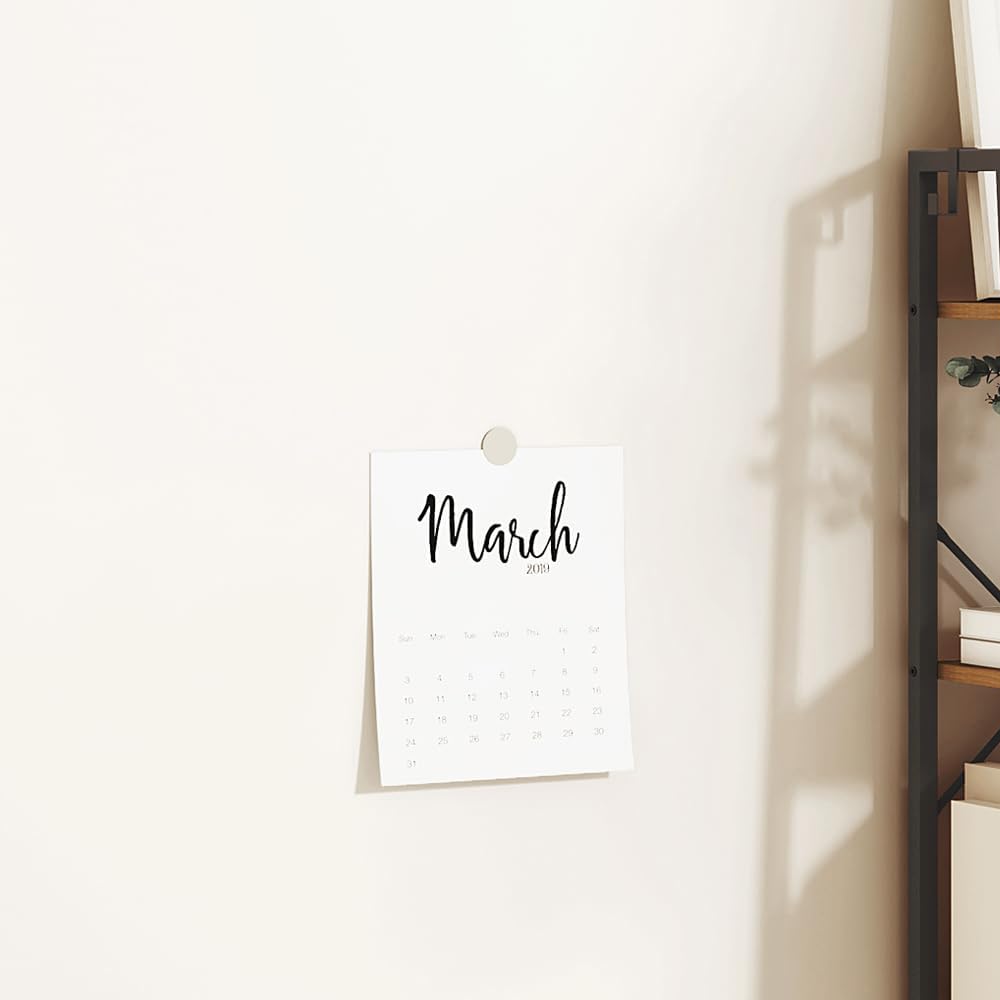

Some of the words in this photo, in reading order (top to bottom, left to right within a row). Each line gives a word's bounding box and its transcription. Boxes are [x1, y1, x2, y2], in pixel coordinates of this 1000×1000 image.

[417, 480, 580, 563] March
[526, 563, 550, 575] 2019
[403, 696, 415, 705] 10
[436, 695, 446, 703] 11
[467, 693, 478, 702] 12
[499, 692, 510, 701] 13
[530, 689, 541, 697] 14
[561, 688, 571, 697] 15
[592, 686, 602, 695] 16
[404, 717, 415, 726] 17
[437, 715, 448, 725] 18
[467, 714, 479, 723] 19
[498, 712, 510, 721] 20
[530, 710, 541, 720] 21
[561, 708, 572, 717] 22
[592, 706, 603, 715] 23
[405, 738, 416, 748] 24
[437, 736, 449, 745] 25
[468, 735, 480, 744] 26
[500, 733, 511, 742] 27
[531, 731, 543, 740] 28
[562, 728, 574, 738] 29
[594, 727, 605, 736] 30
[407, 759, 417, 769] 31
